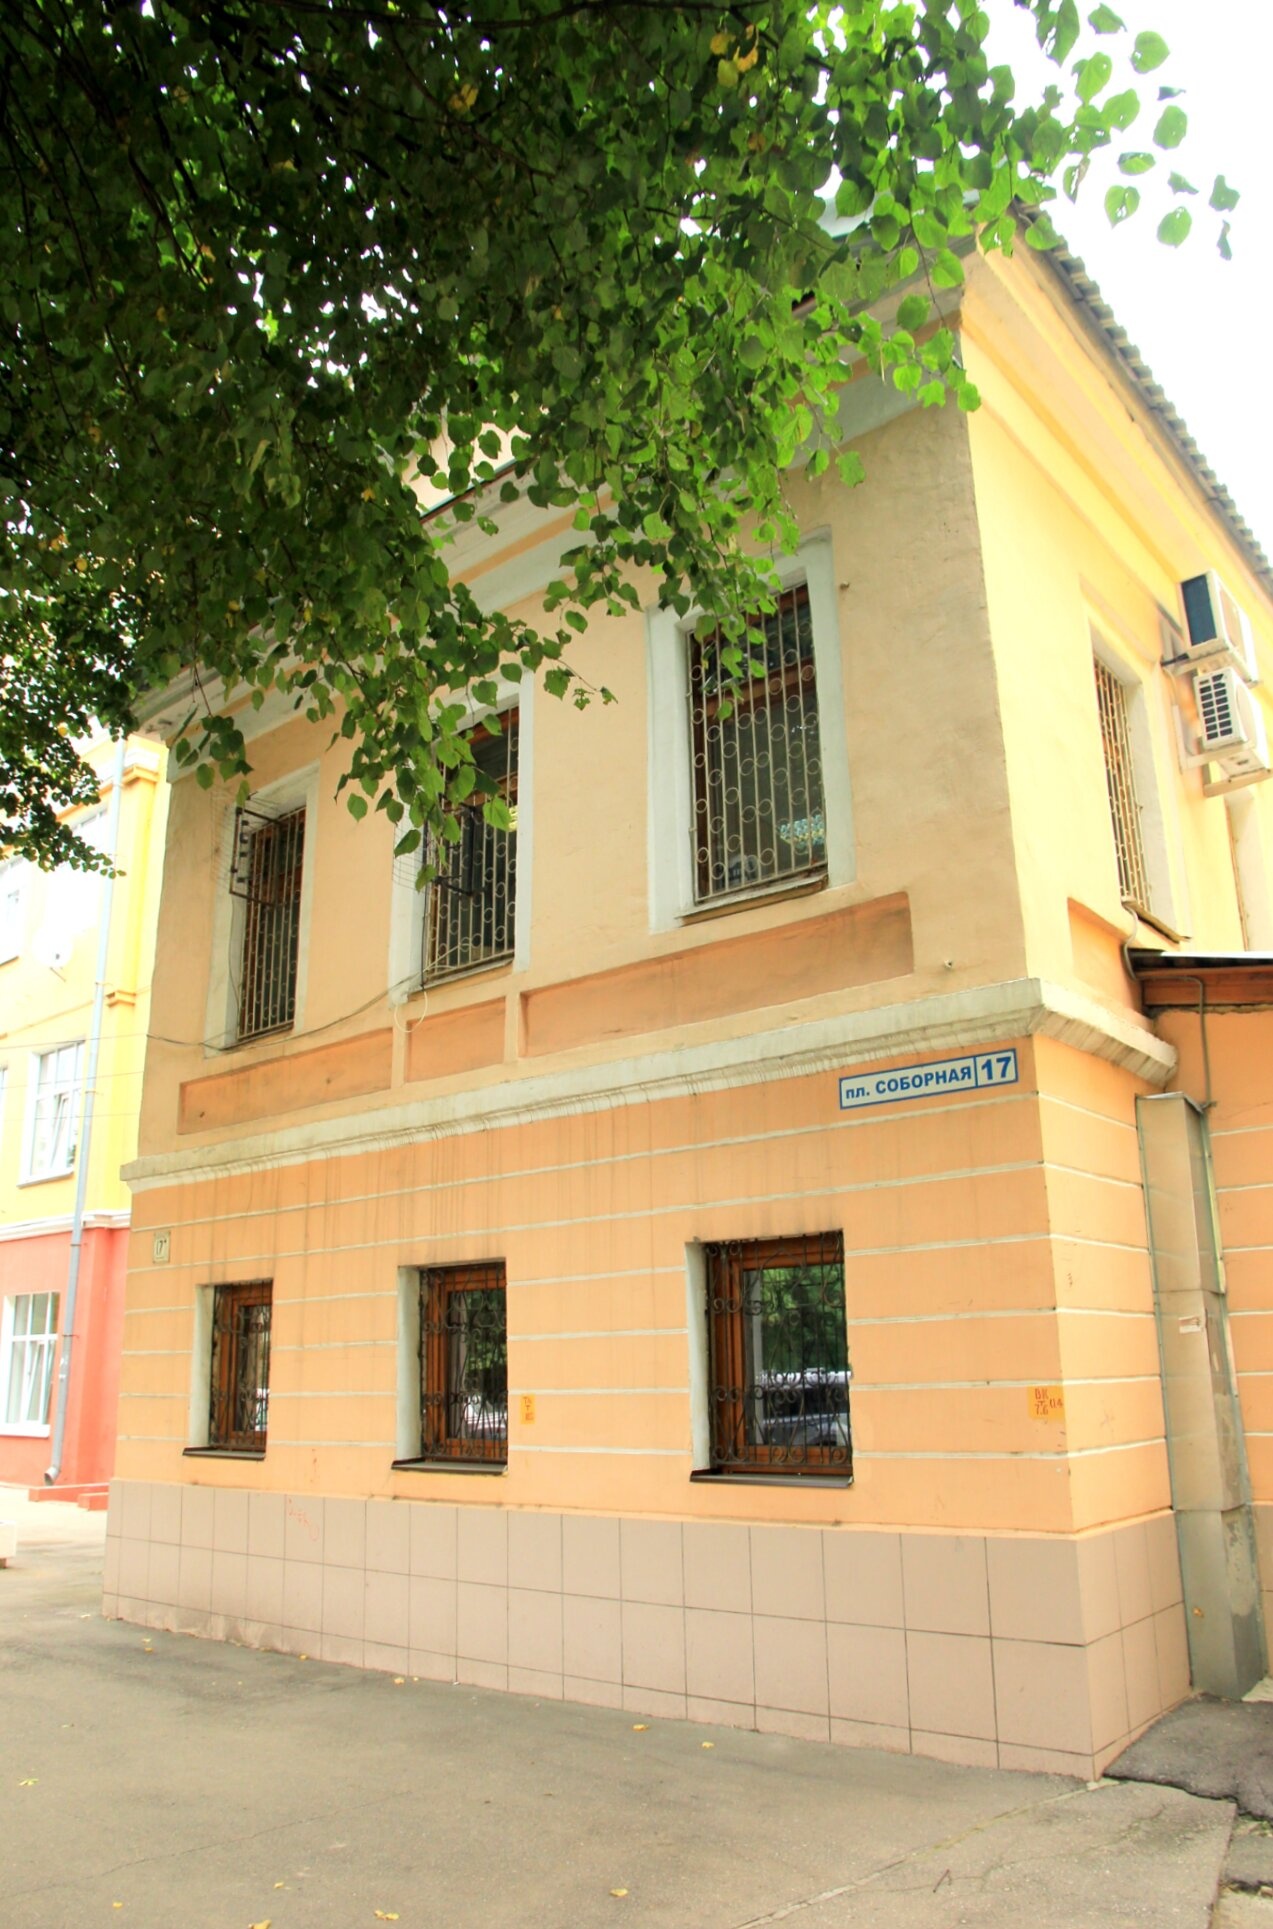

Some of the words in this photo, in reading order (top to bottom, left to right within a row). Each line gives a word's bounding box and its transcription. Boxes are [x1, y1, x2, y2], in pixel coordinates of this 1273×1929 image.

[845, 1087, 870, 1099] пл.
[875, 1066, 972, 1094] СОБОРНАЯ
[981, 1056, 1012, 1080] 17
